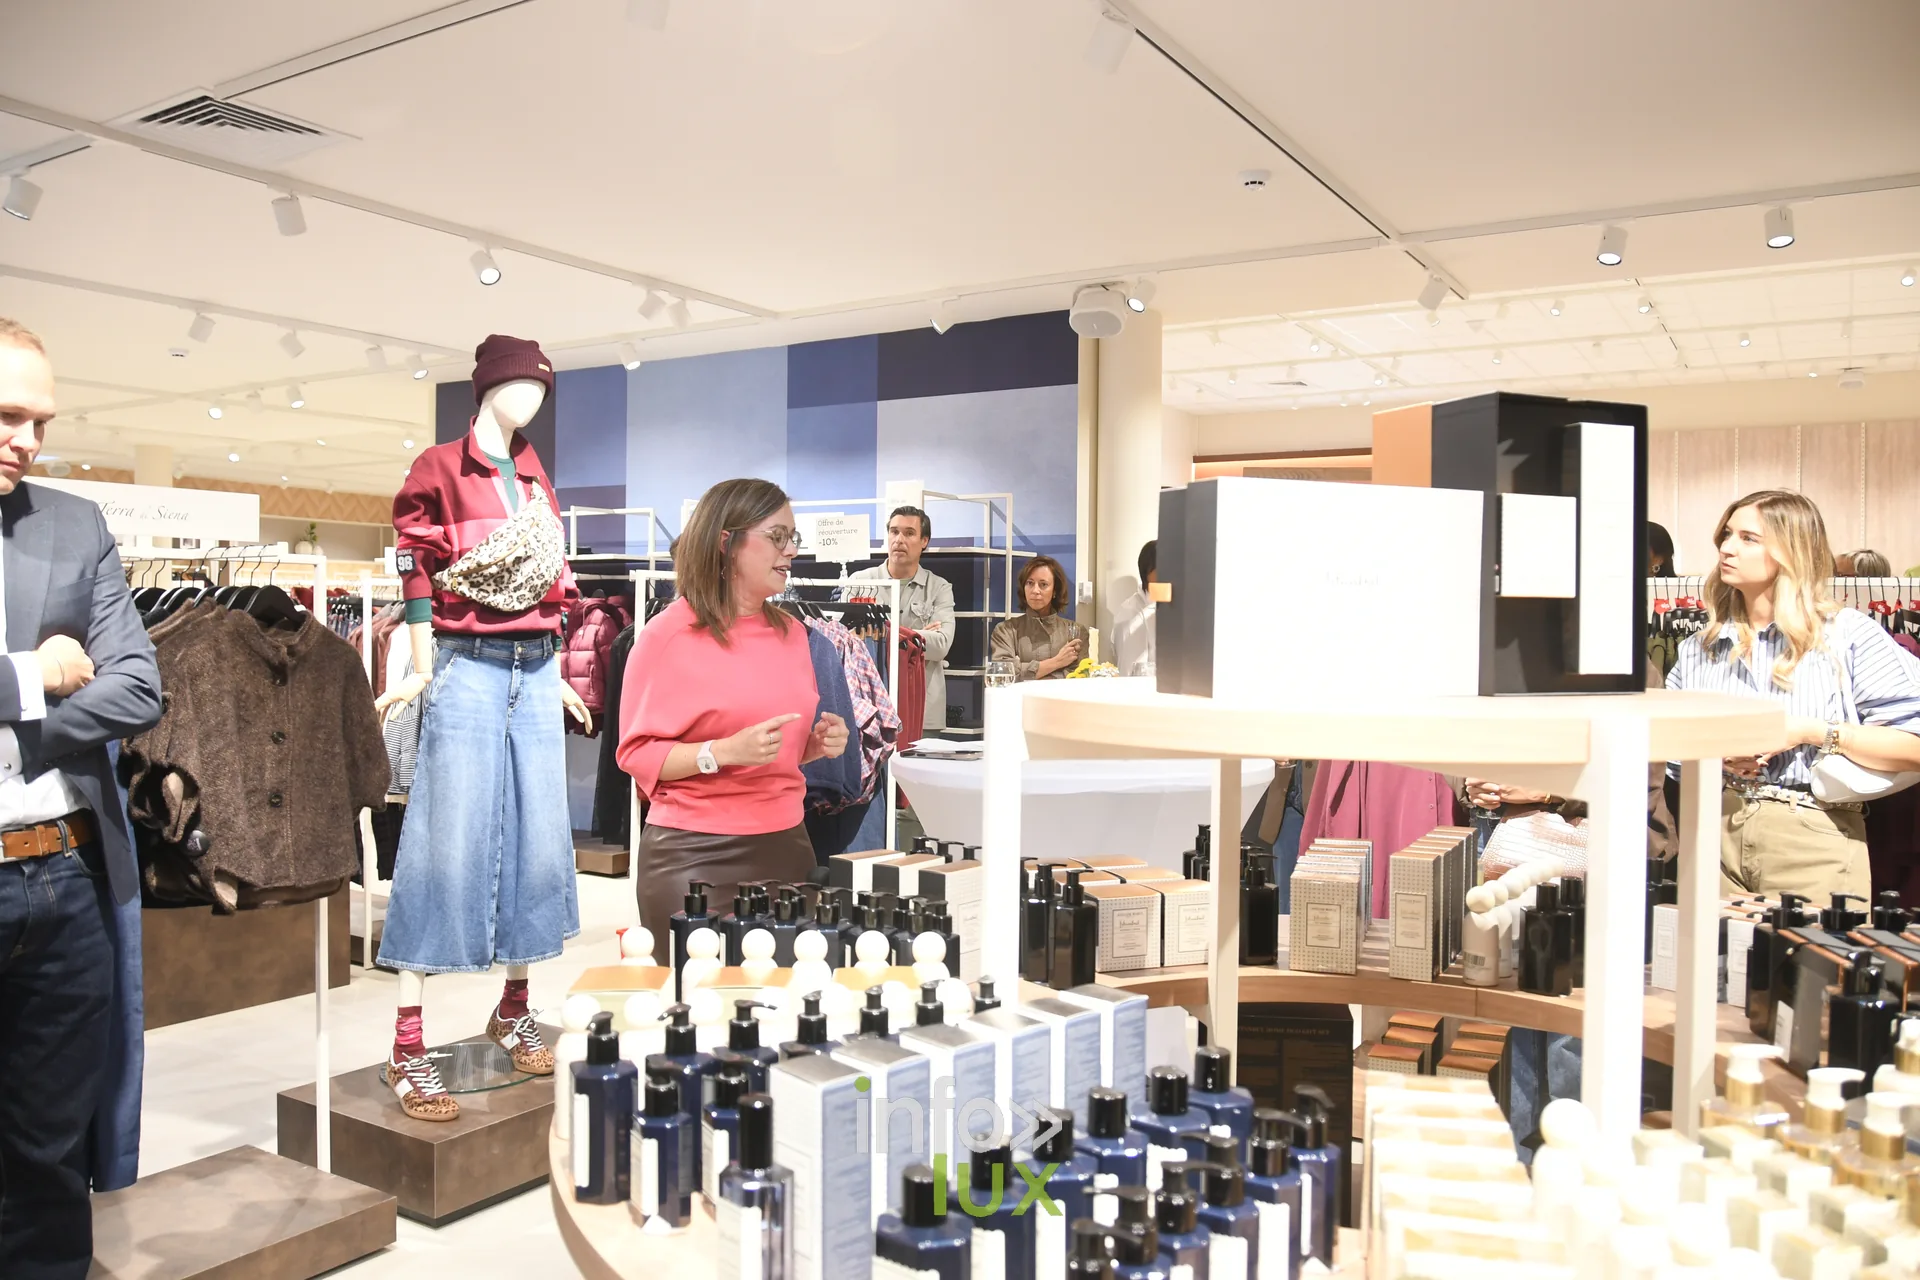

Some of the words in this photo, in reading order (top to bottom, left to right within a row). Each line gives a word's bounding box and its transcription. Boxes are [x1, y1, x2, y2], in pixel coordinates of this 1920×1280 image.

[98, 500, 135, 518] Terra
[152, 505, 189, 521] Siena
[817, 519, 834, 527] Offre
[818, 528, 858, 536] réouverture
[819, 537, 838, 546] -10%
[397, 555, 413, 571] 96
